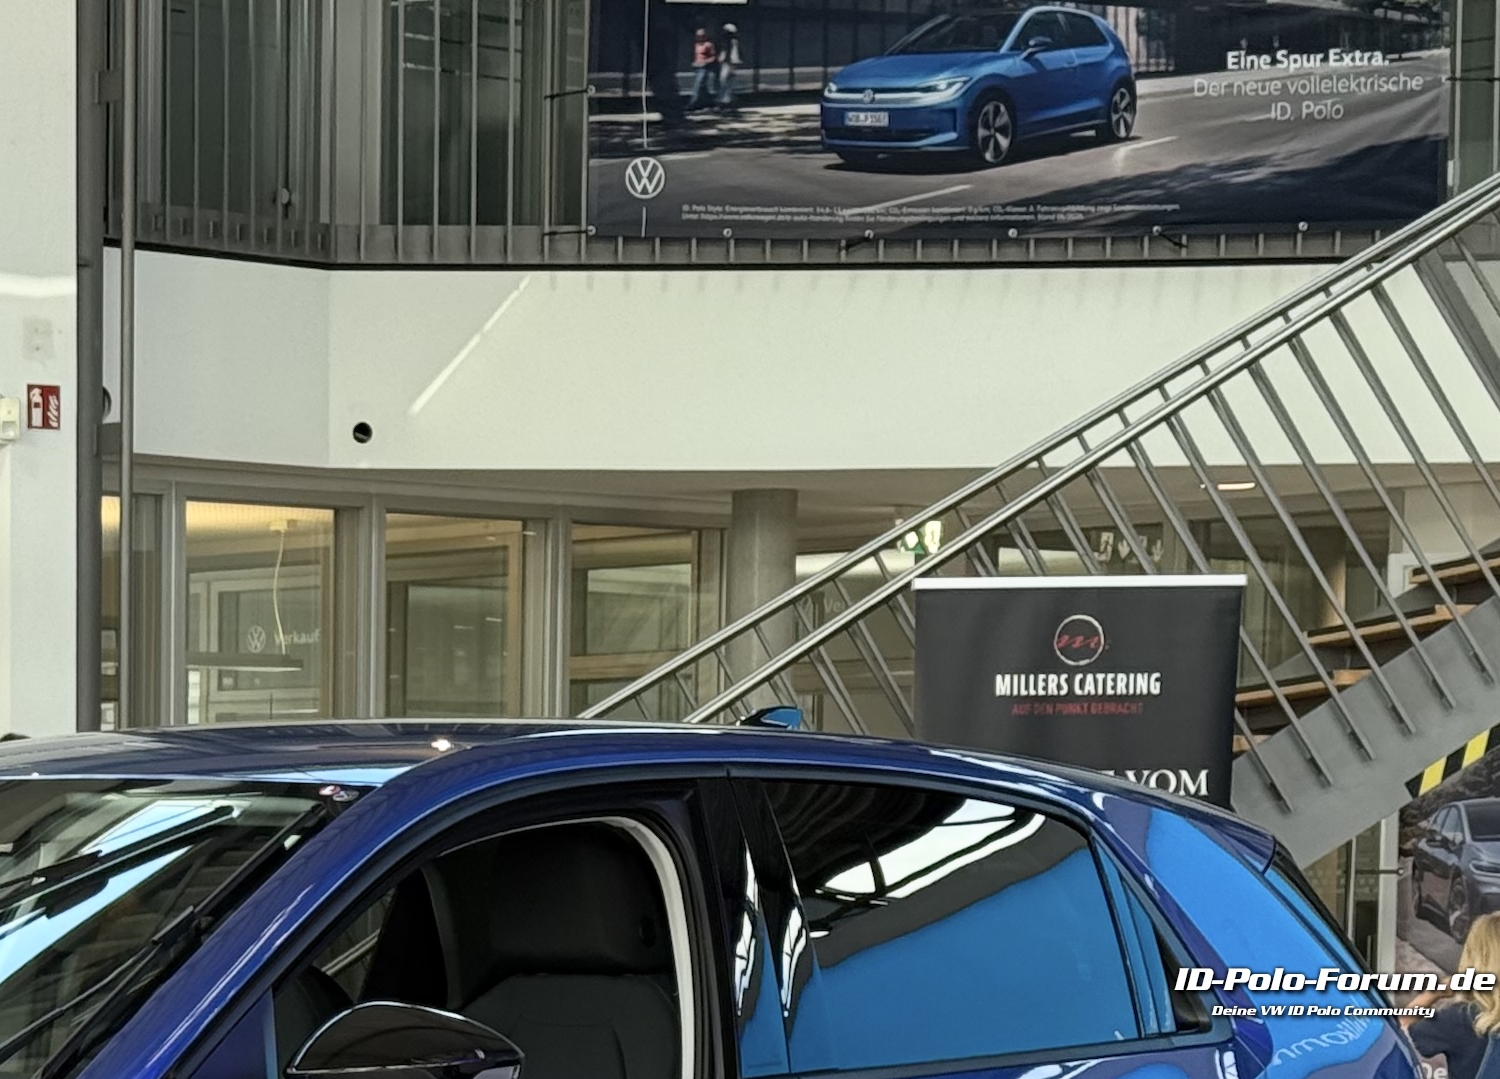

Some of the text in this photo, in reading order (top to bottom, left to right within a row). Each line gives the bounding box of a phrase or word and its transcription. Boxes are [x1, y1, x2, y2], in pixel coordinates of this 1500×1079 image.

[1226, 48, 1390, 73] Eine Spur Extra.
[1193, 74, 1424, 97] Der neue vollelektrische
[1301, 102, 1345, 120] Polo
[995, 672, 1163, 697] MILLERS CATERING
